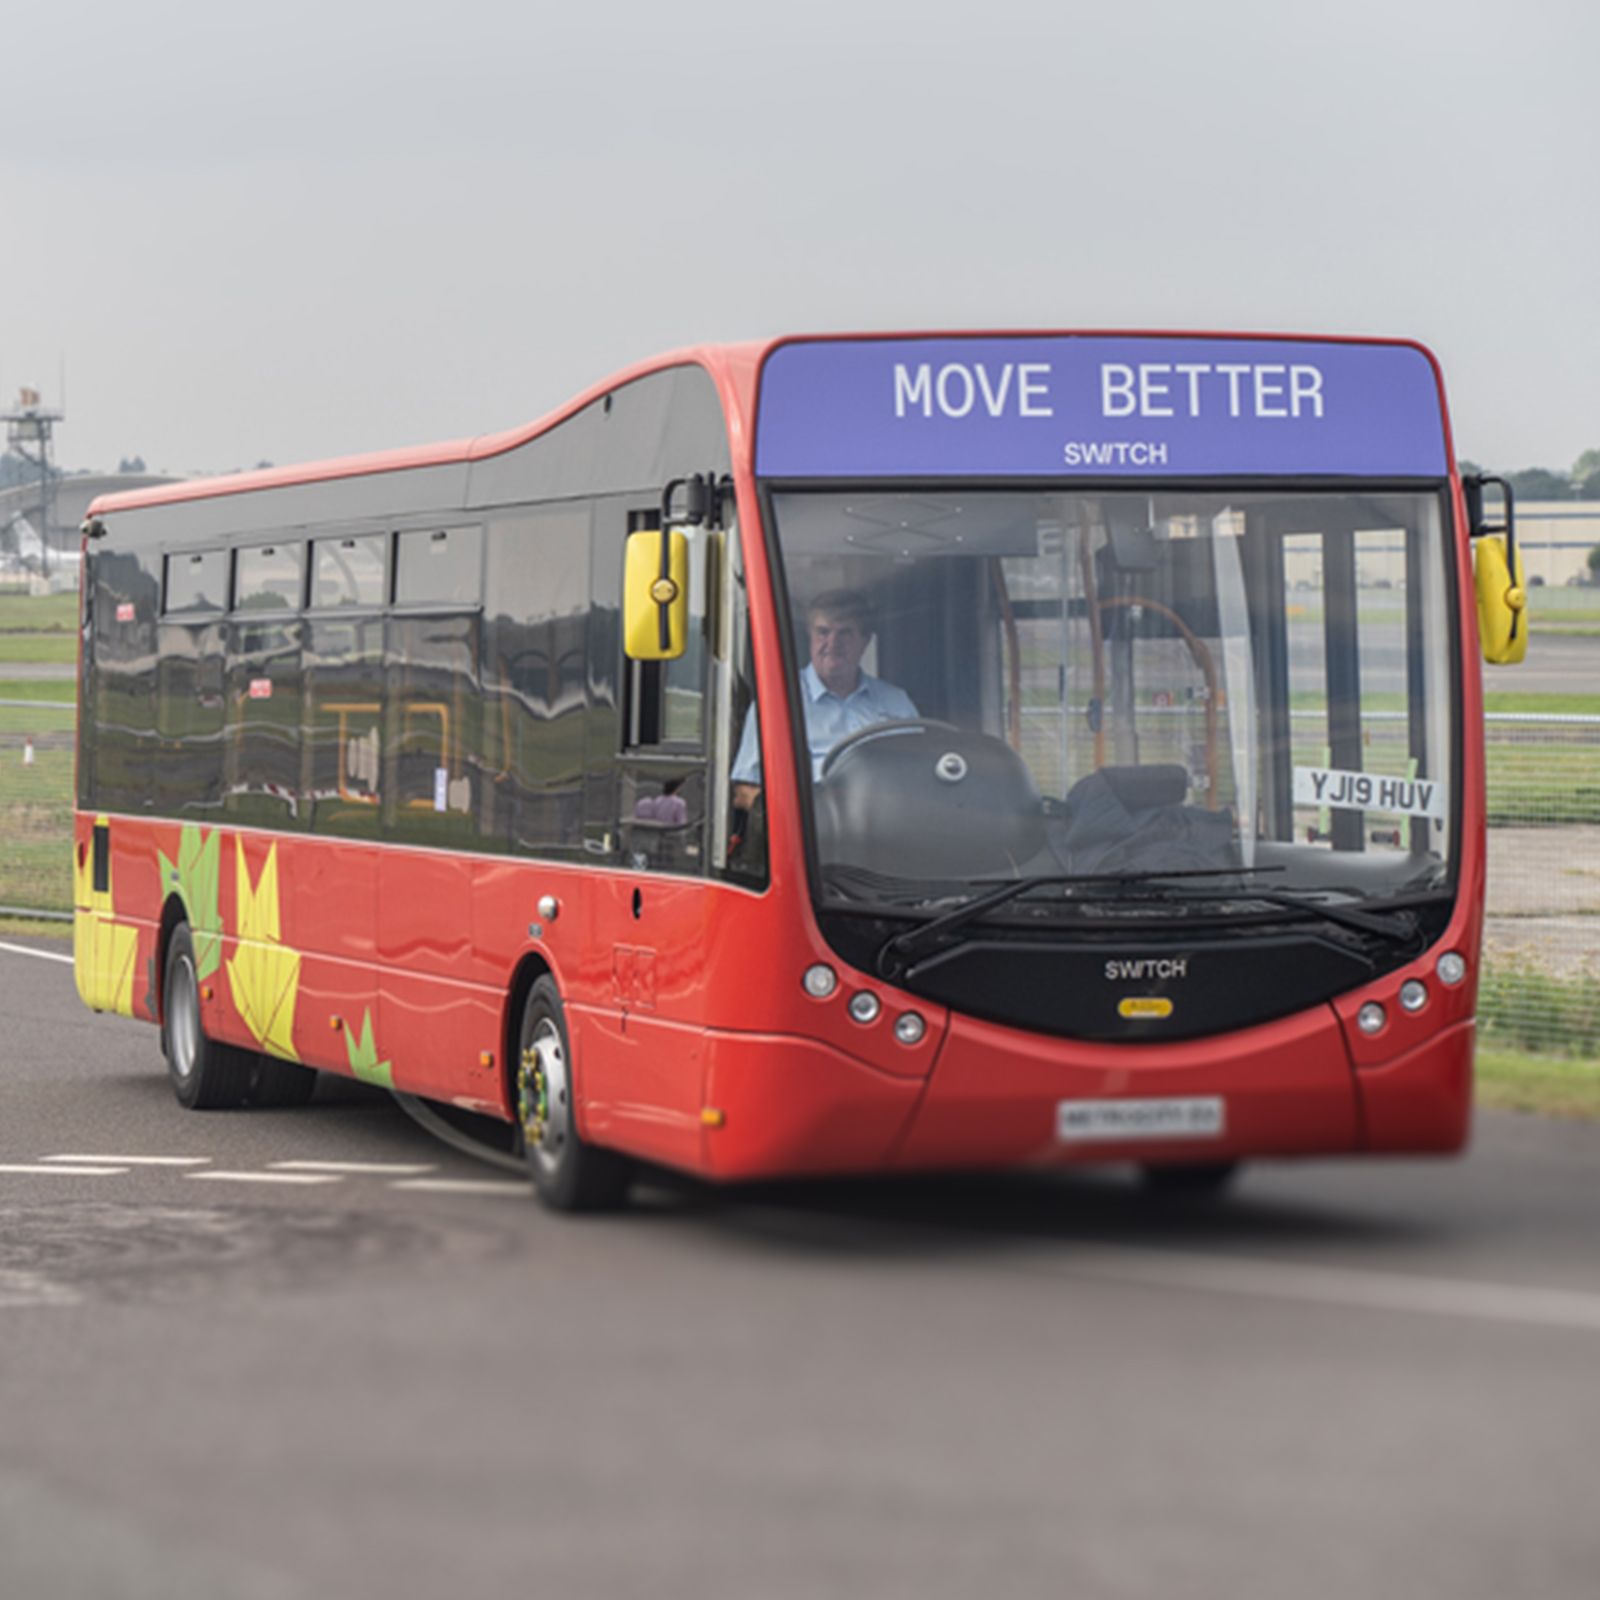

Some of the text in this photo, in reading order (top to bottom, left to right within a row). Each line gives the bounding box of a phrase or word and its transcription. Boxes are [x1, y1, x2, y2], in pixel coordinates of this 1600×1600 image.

[894, 363, 1324, 418] MOVE BETTER
[1063, 442, 1168, 465] SWITCH
[1311, 771, 1433, 811] YJ19 HUV
[1104, 959, 1187, 980] SWITCH
